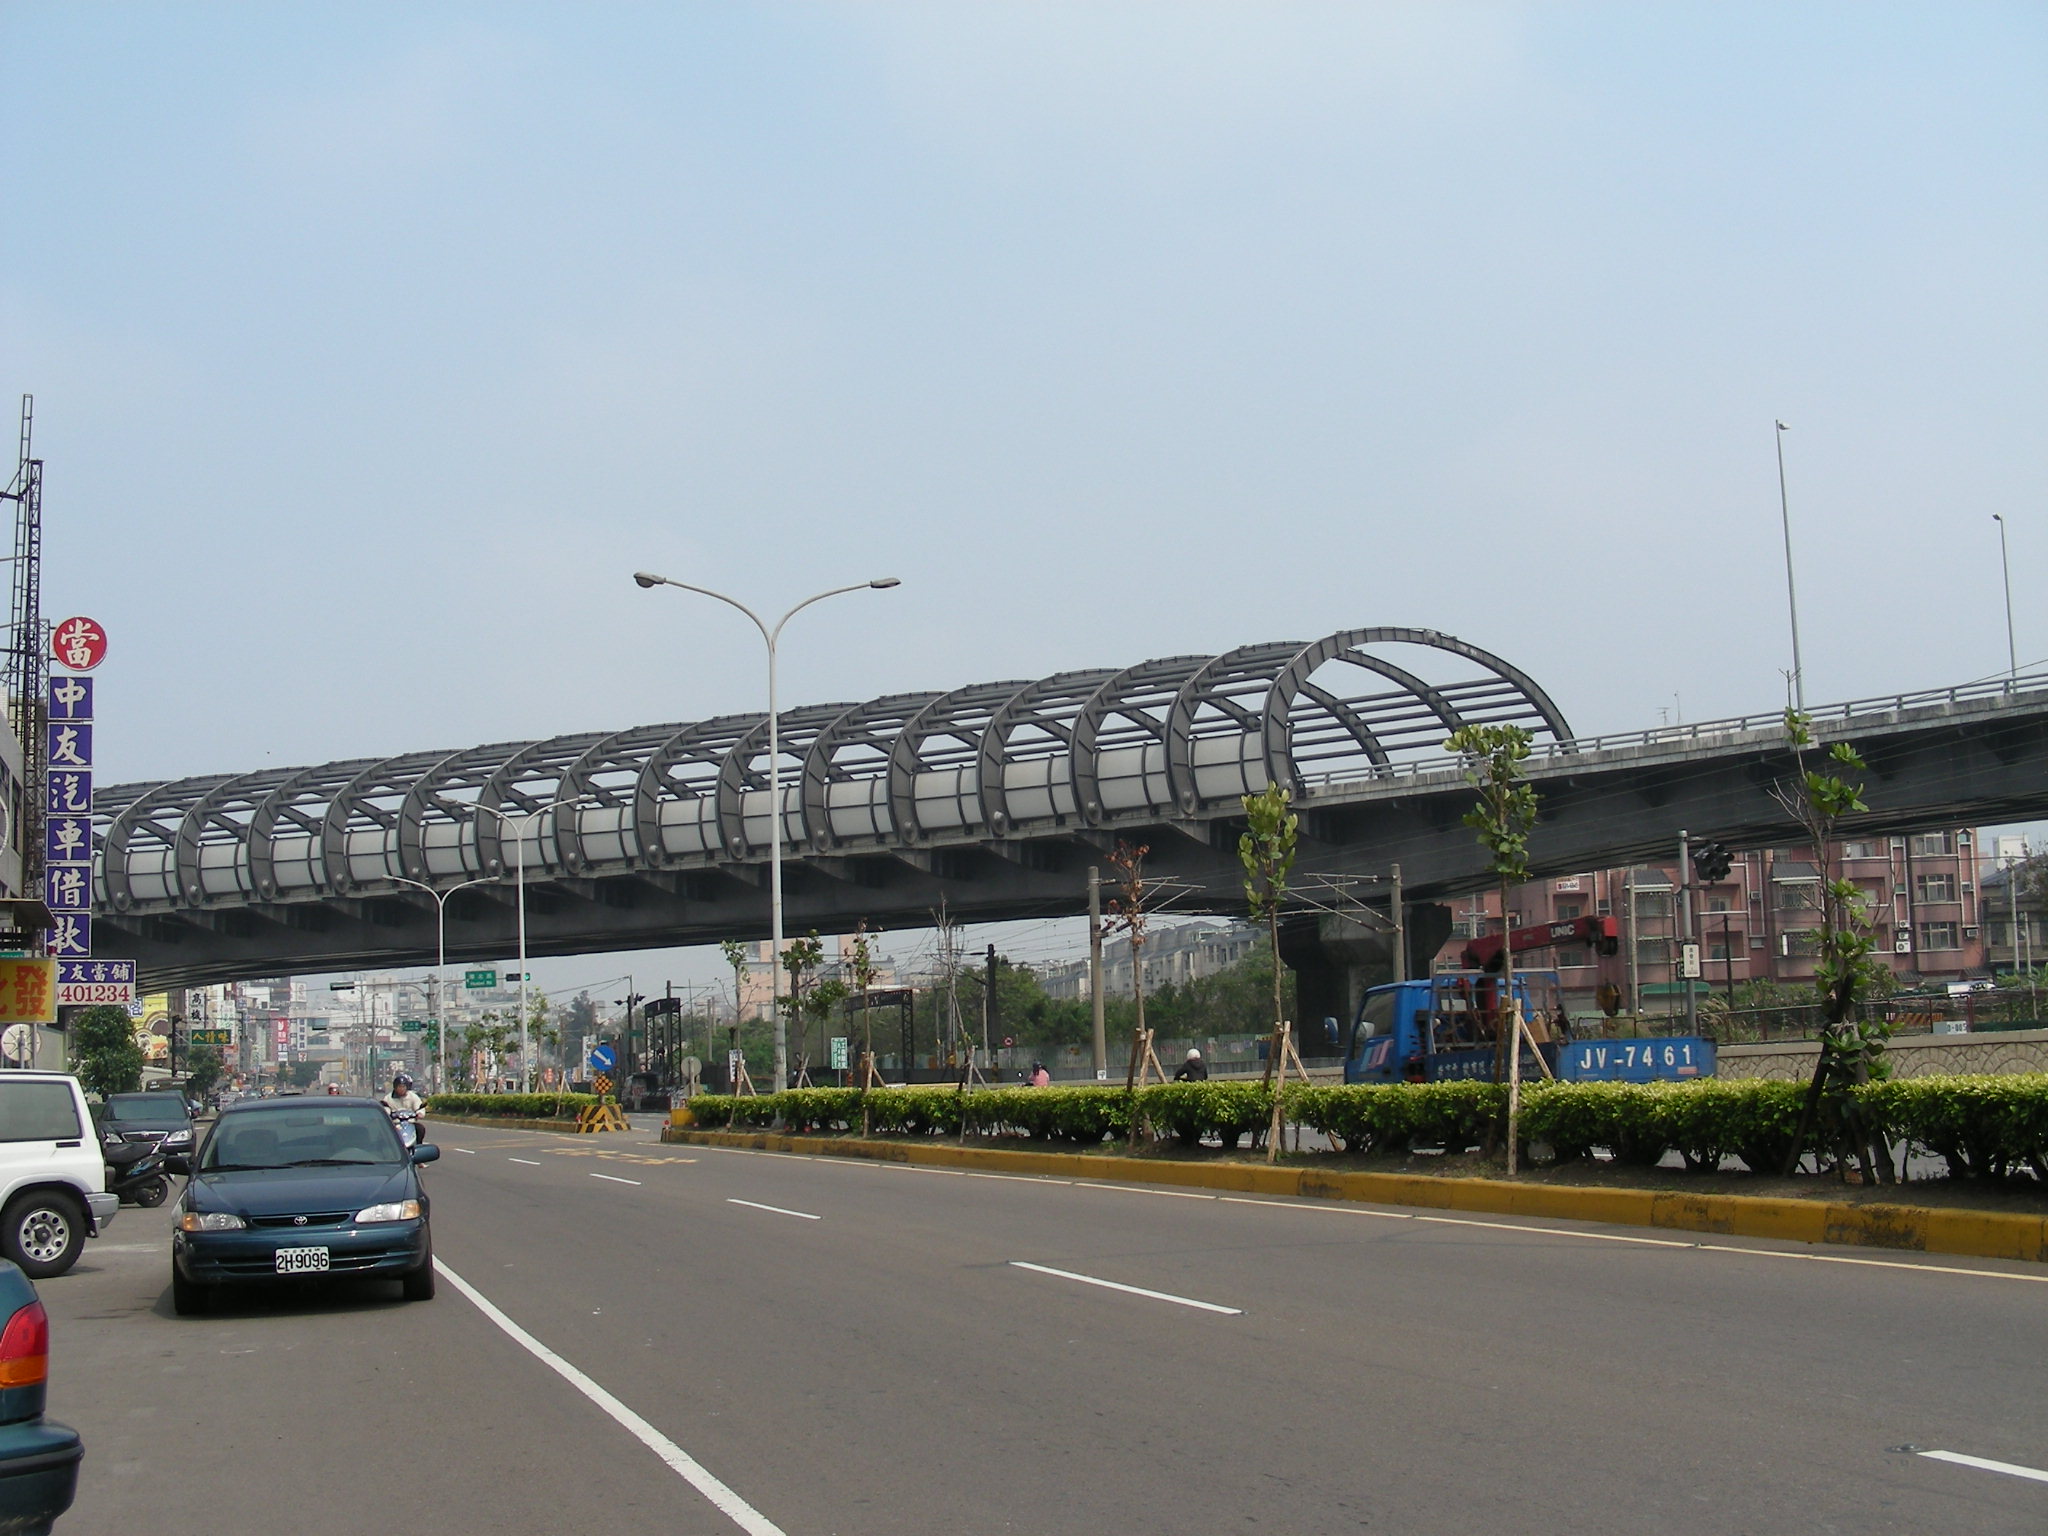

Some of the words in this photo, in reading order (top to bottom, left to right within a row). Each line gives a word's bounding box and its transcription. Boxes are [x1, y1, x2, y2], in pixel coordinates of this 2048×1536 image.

[61, 618, 100, 667] 當
[47, 677, 89, 953] 中友汽車借款
[1551, 924, 1575, 939] UNIC
[0, 965, 48, 1017] 發
[57, 985, 130, 1002] 401234
[1580, 1044, 1692, 1070] JV-7461
[276, 1252, 328, 1271] 2H-9096
